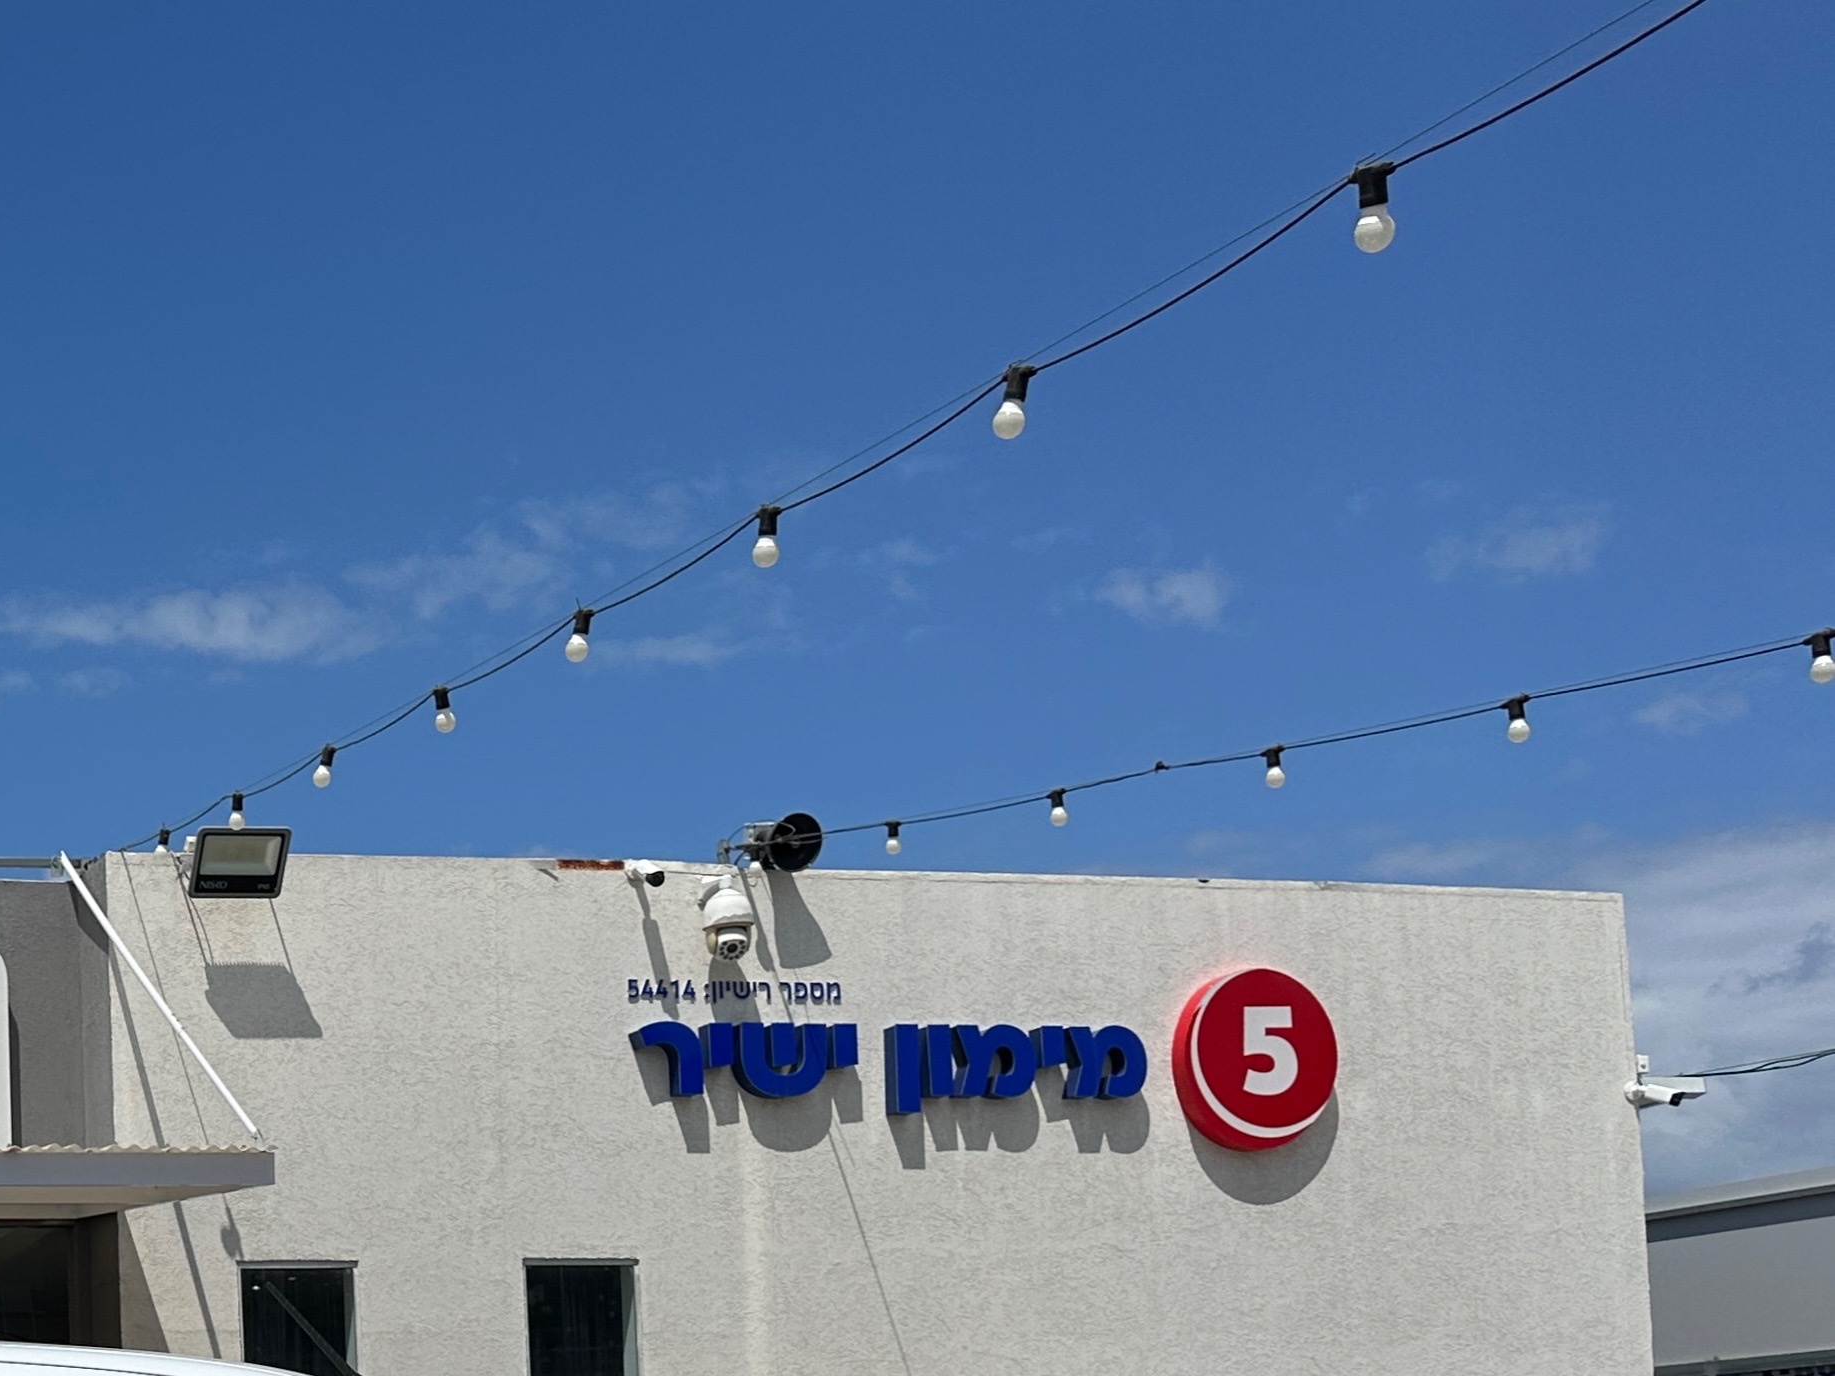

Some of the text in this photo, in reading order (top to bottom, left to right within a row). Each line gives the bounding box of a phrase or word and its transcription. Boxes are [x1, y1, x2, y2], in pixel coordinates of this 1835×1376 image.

[627, 979, 842, 1004] מספר רישיון: 54414
[628, 1020, 1149, 1115] מימון ישיר
[1242, 1005, 1298, 1097] 5
